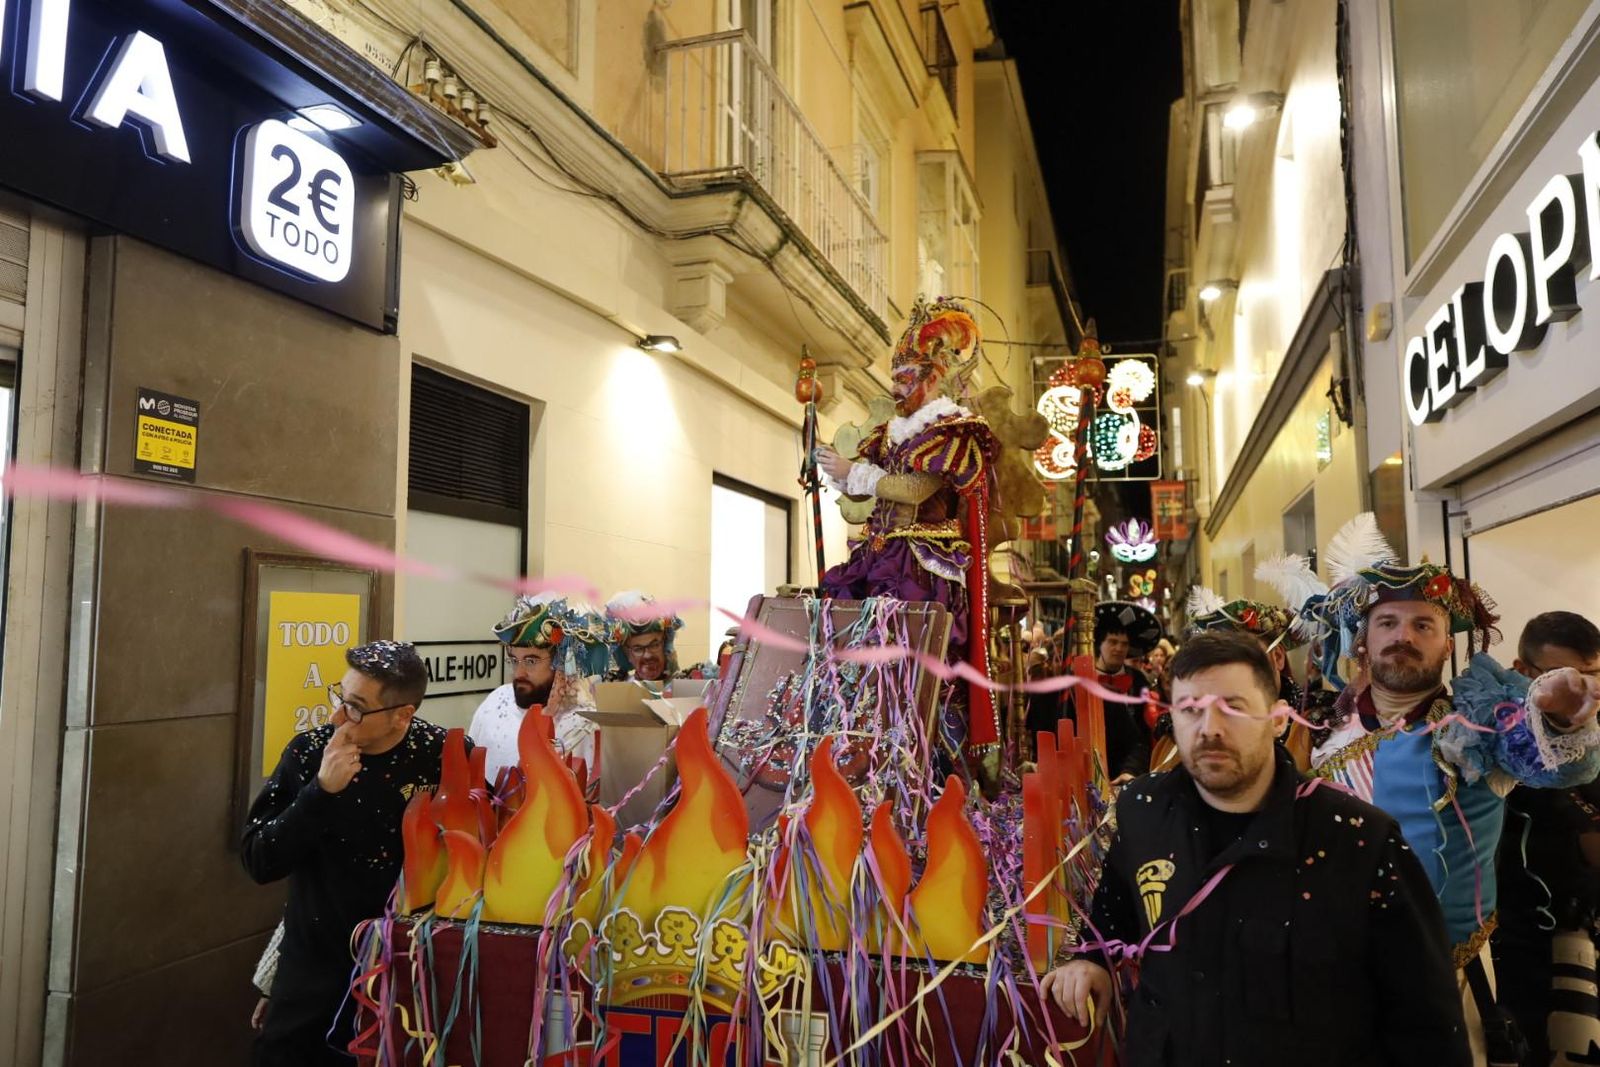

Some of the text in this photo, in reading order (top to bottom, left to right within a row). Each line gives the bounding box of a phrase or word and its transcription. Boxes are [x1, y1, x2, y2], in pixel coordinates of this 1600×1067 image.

[0, 0, 192, 165] IA
[267, 144, 342, 235] 2€
[266, 211, 339, 264] TODO
[142, 422, 193, 440] CONECTADA
[279, 622, 349, 647] TODO
[303, 663, 324, 689] A
[425, 654, 498, 682] ALE-HOP
[294, 705, 330, 732] 2€
